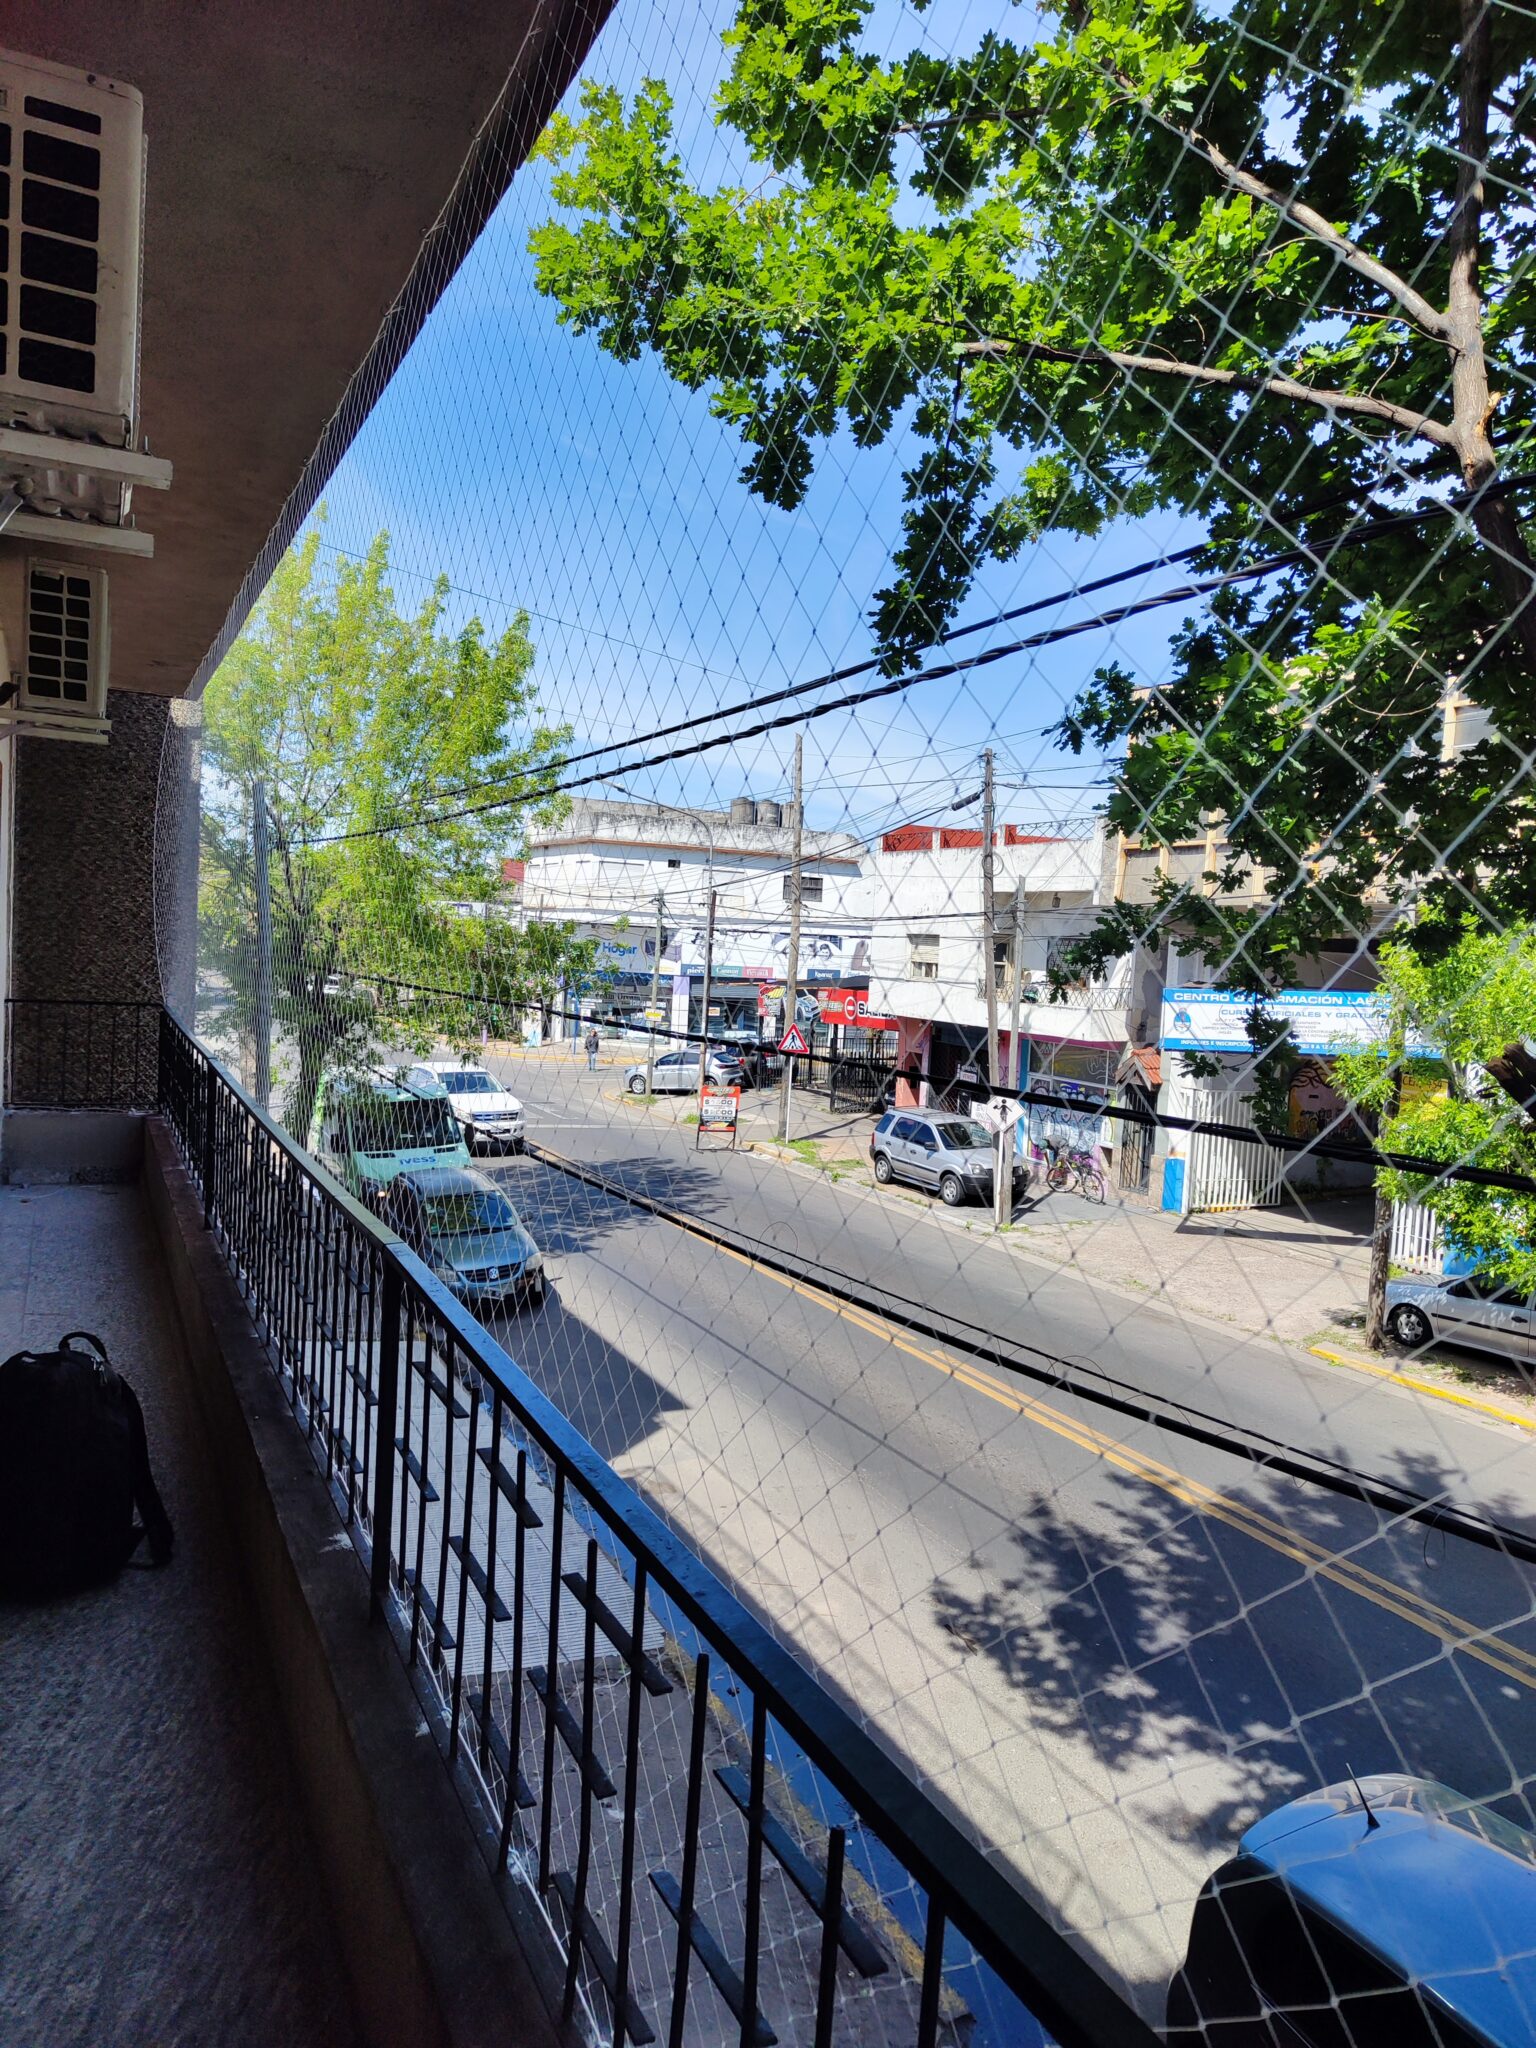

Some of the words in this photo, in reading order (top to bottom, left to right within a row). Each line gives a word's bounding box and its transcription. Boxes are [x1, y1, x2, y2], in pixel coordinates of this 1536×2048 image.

[603, 942, 637, 956] Hogar
[687, 966, 705, 974] pier
[1174, 992, 1230, 1002] CENTRO
